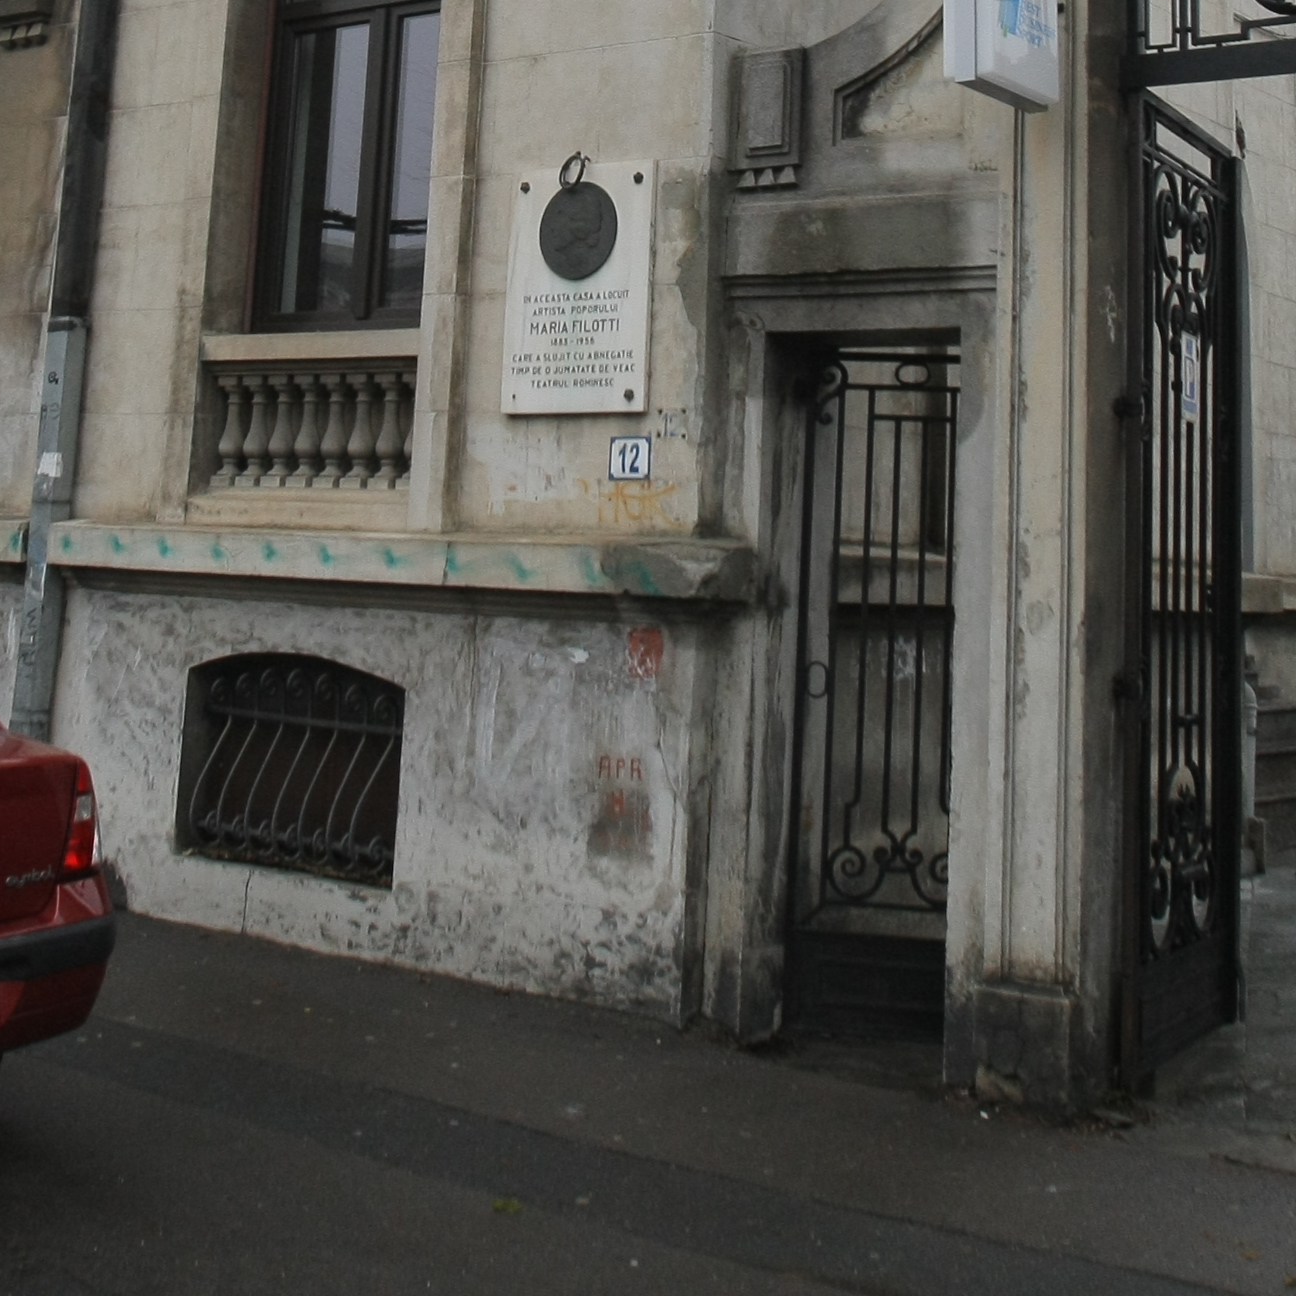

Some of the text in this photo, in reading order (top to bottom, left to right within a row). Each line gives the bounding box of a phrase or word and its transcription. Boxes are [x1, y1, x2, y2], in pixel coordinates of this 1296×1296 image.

[572, 291, 594, 302] CASA
[595, 290, 601, 300] A
[602, 289, 630, 300] LOCUIT
[532, 303, 619, 317] ARTISTA POPORULUI
[529, 317, 621, 335] MARIA FILOTTI
[511, 352, 533, 363] CARE
[535, 353, 541, 362] A
[543, 351, 571, 362] SLUJIT
[573, 351, 585, 361] CU
[510, 365, 530, 376] TIMP
[532, 365, 542, 375] DE
[545, 365, 551, 375] O
[598, 364, 609, 374] DE
[612, 362, 636, 373] VEAC
[531, 379, 569, 389] TEATRUL
[618, 442, 640, 474] 12
